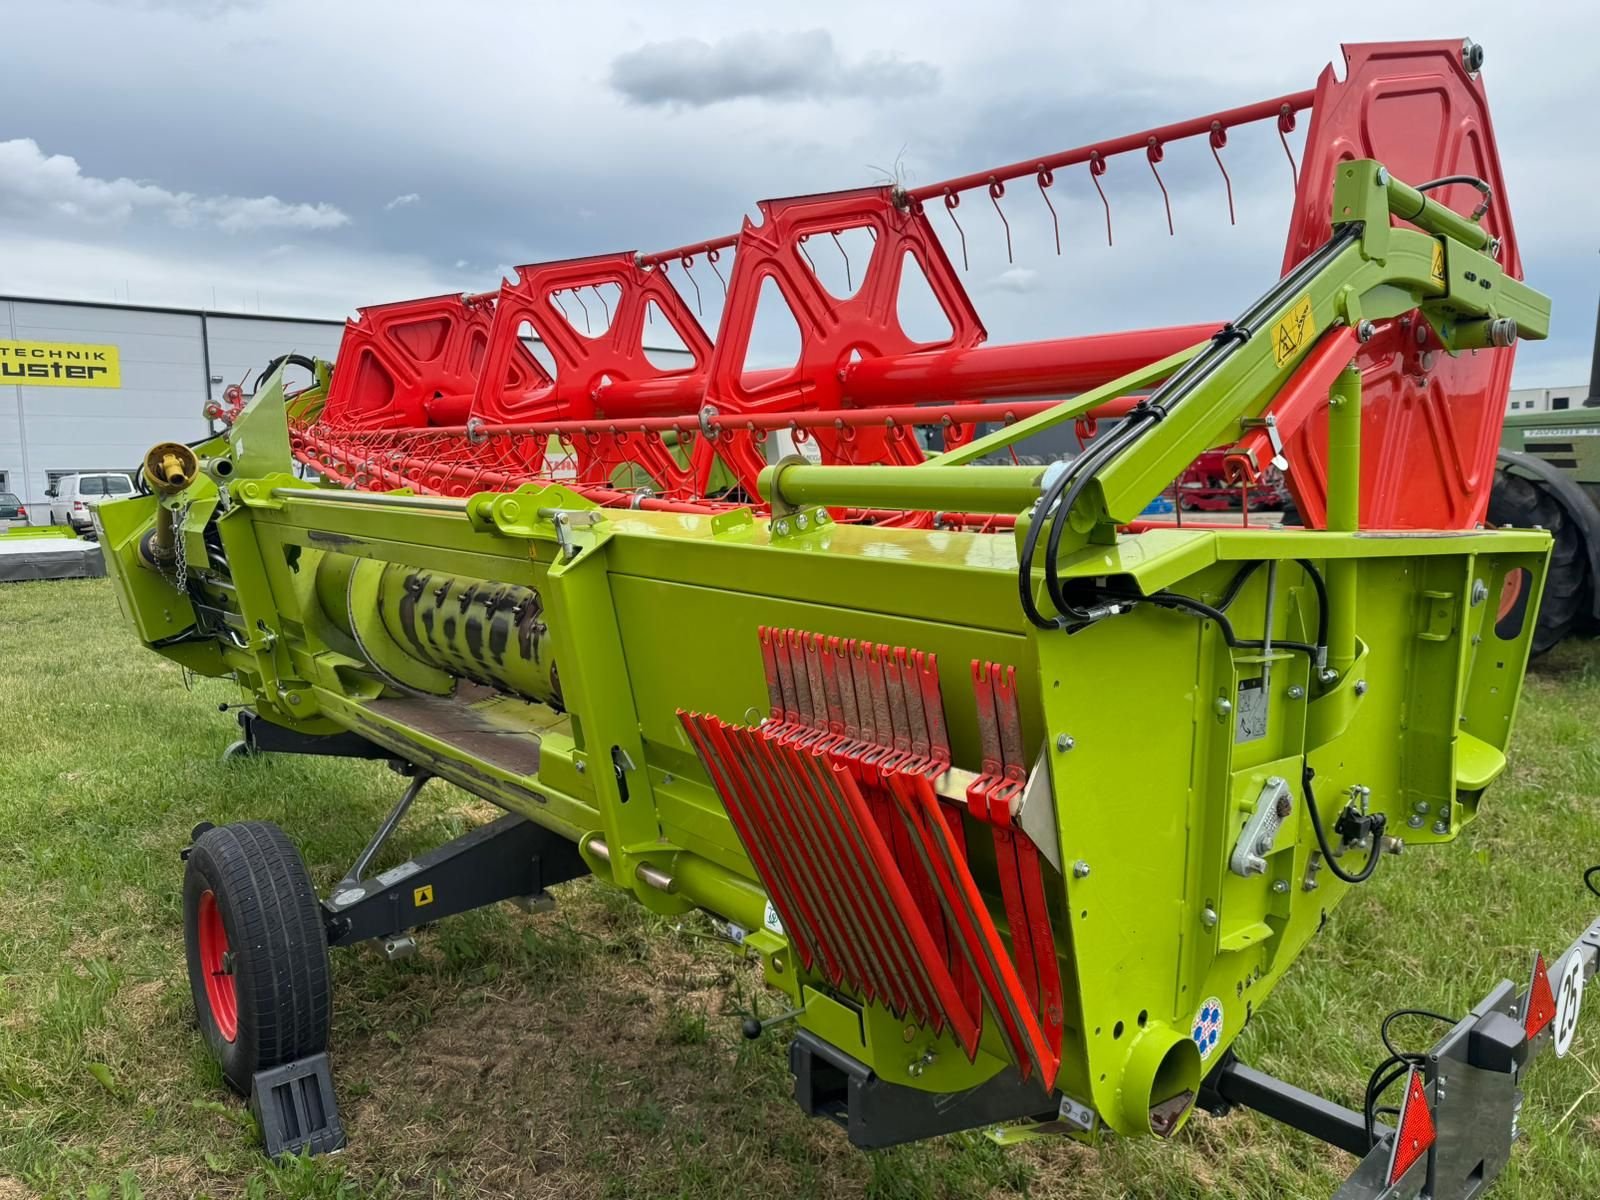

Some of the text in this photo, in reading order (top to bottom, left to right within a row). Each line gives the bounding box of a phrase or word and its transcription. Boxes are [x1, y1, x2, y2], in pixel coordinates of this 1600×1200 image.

[0, 347, 105, 360] TECHNIK
[2, 362, 107, 379] uster
[1559, 964, 1579, 1044] 25
